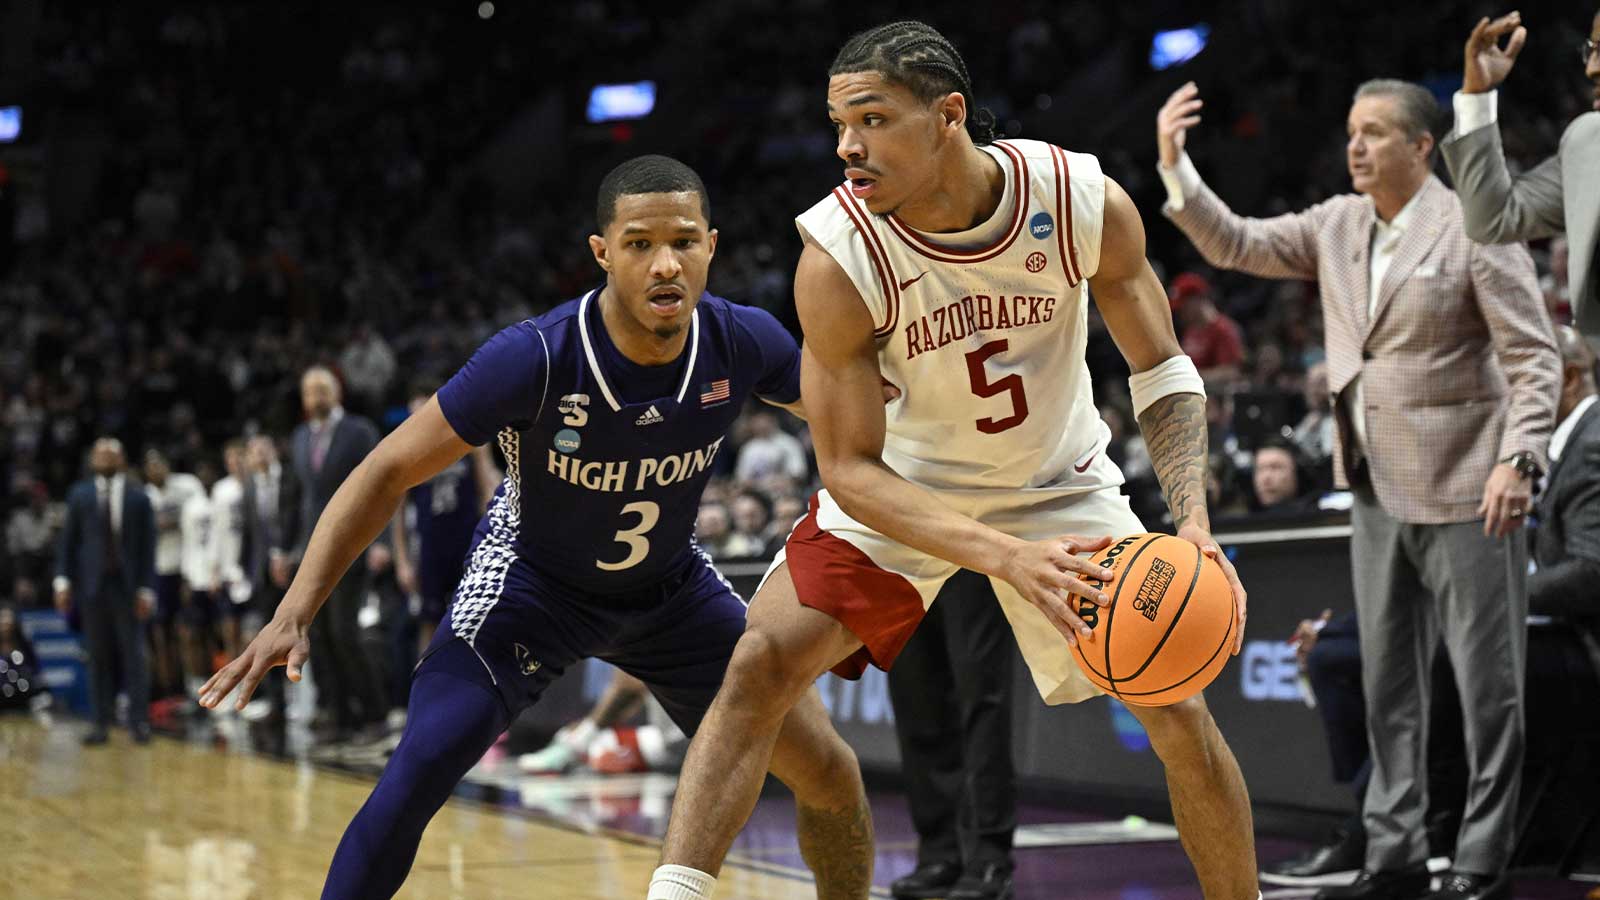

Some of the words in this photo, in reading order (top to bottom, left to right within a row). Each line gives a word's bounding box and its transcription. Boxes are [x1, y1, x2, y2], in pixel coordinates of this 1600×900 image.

[1027, 254, 1046, 271] SEC
[905, 295, 1056, 360] RAZORBACKS
[965, 338, 1029, 434] 5
[635, 415, 664, 425] adidas
[548, 449, 628, 492] HIGH
[635, 435, 725, 491] POINT
[596, 501, 660, 571] 3
[1079, 536, 1140, 630] Wlson
[1138, 569, 1160, 603] MARCH
[1148, 563, 1174, 602] MADNESS
